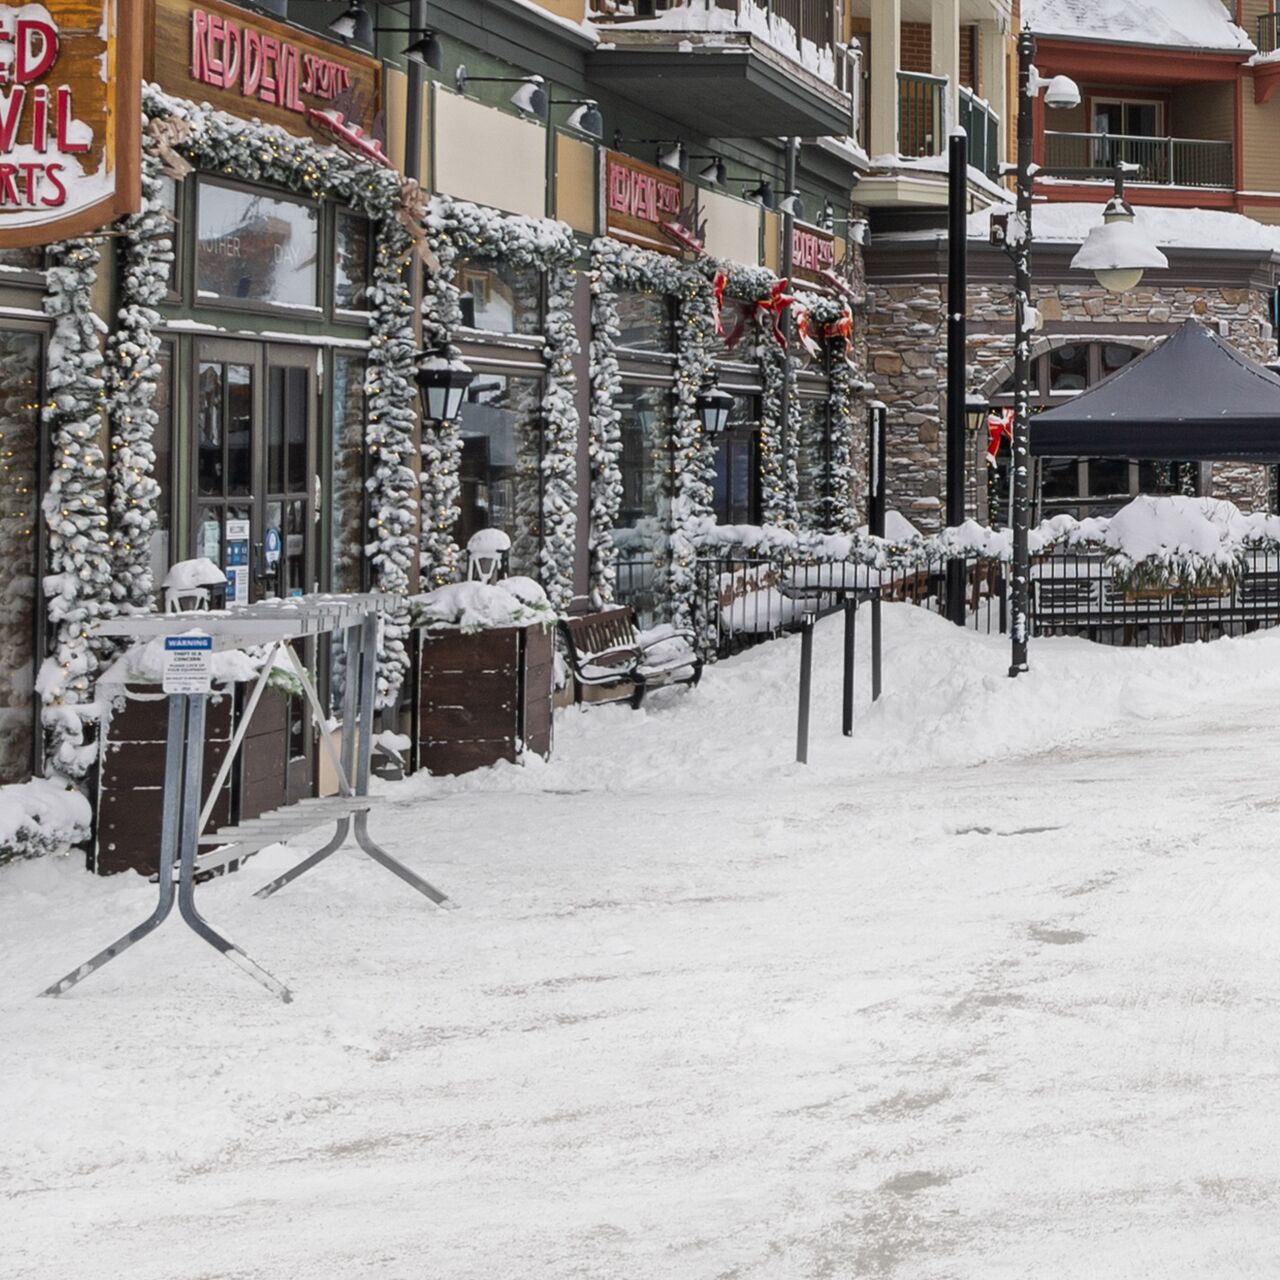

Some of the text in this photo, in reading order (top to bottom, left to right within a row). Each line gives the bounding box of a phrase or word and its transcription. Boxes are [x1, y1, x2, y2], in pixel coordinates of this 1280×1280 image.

[192, 9, 241, 90] RED
[302, 53, 350, 100] SPORTS
[168, 639, 209, 648] WARNING
